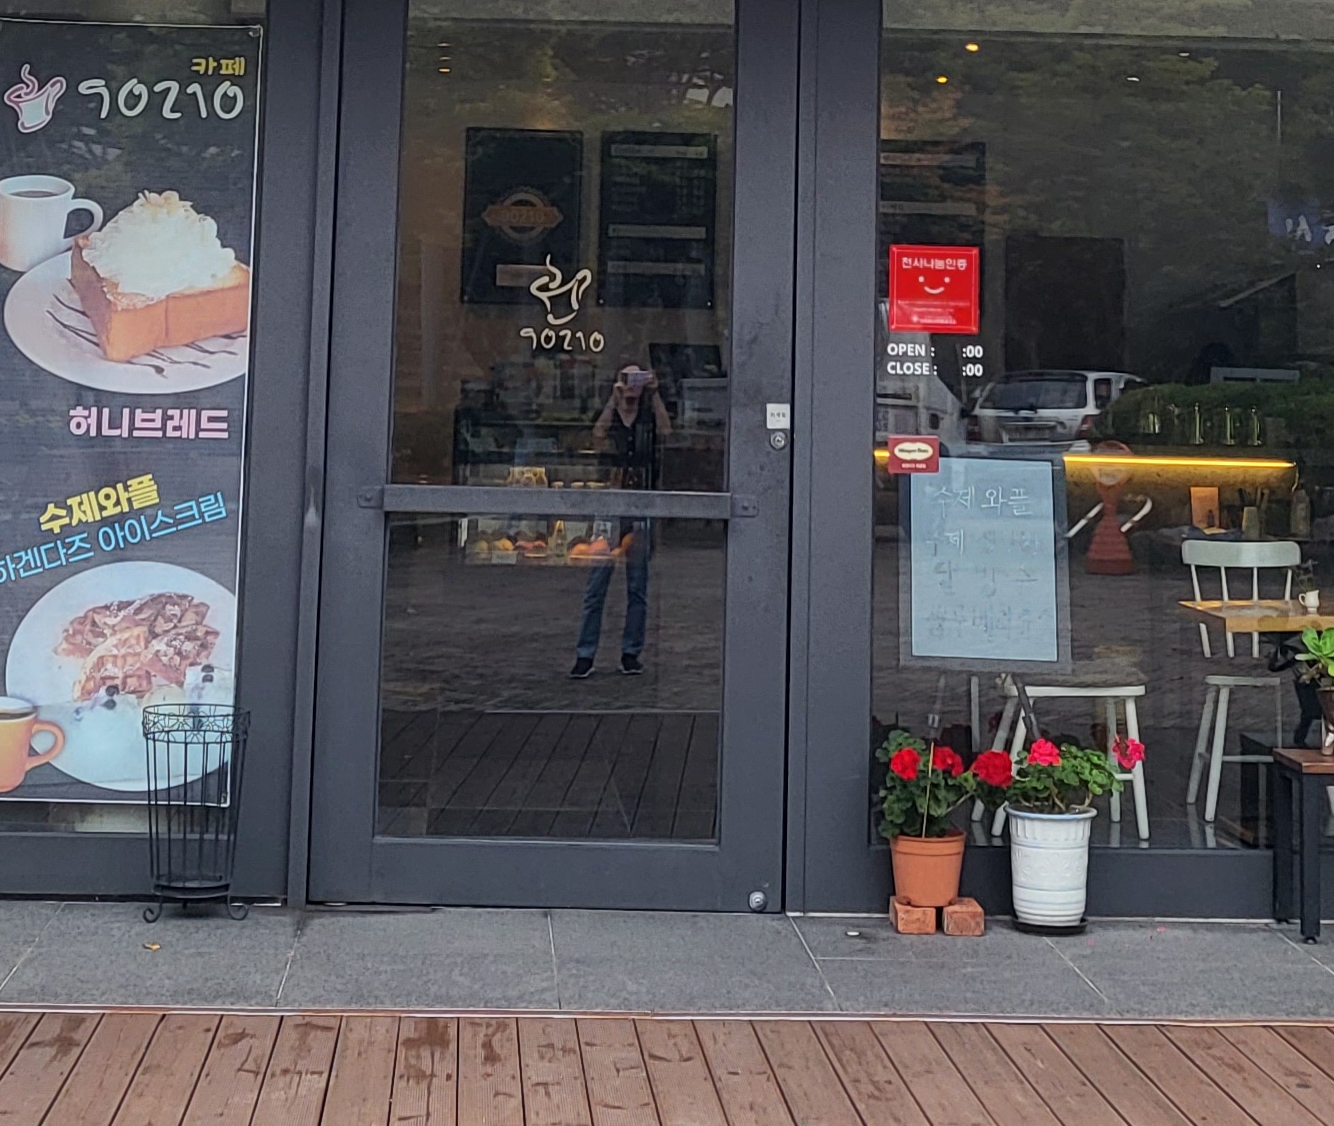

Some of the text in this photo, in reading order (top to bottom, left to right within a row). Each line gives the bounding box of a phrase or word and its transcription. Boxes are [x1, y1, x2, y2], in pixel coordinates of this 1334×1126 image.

[191, 56, 245, 78] 카페
[77, 77, 244, 121] 90210
[520, 328, 604, 352] 90210
[887, 343, 926, 357] OPEN
[887, 361, 930, 375] CLOSE
[68, 407, 229, 441] 허니브레드
[39, 473, 160, 534] 수제와플
[98, 491, 227, 552] 아이스크림
